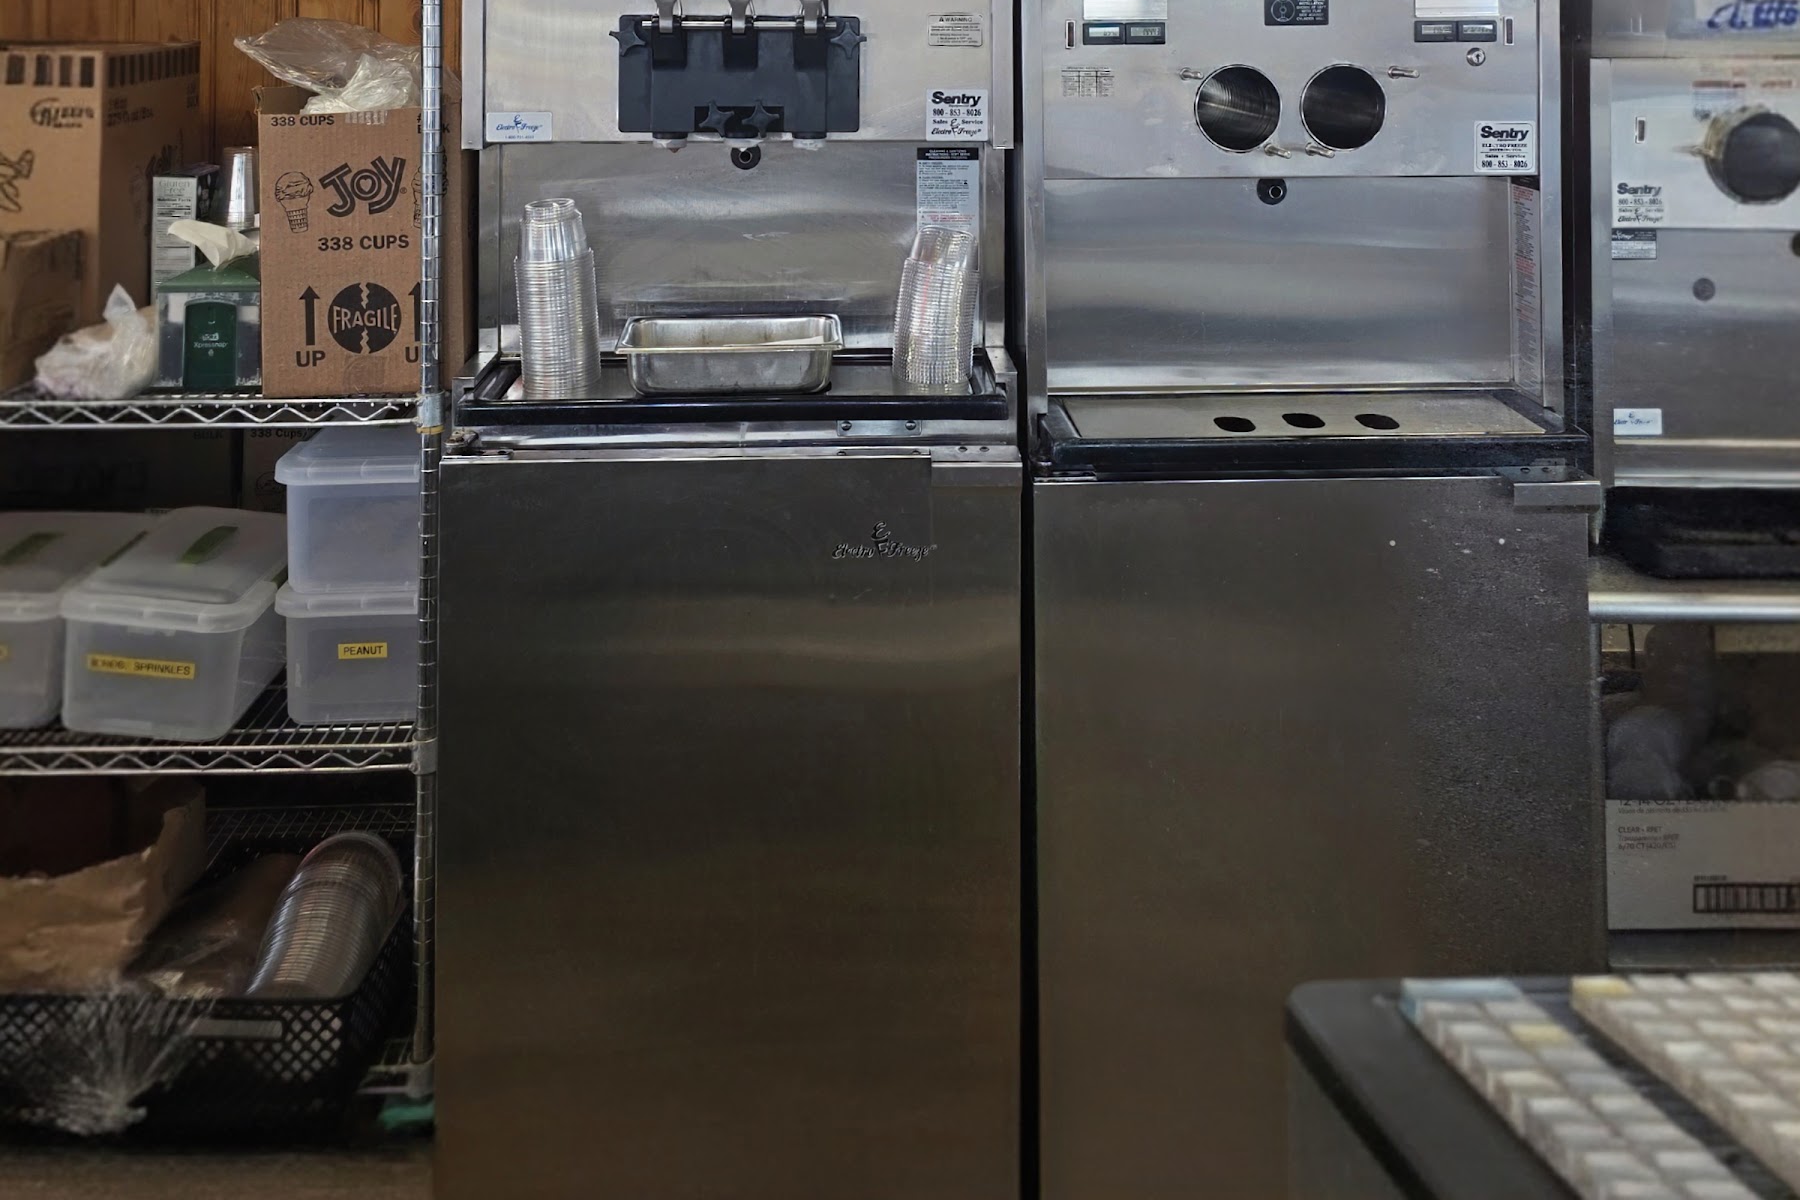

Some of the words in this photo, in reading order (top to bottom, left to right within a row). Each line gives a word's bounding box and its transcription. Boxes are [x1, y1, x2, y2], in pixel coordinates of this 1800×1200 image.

[931, 91, 981, 107] Sentry
[932, 108, 944, 116] 800
[950, 108, 961, 116] 853
[966, 108, 981, 116] 8026
[270, 116, 296, 126] 338
[299, 115, 335, 126] CUPS
[1480, 125, 1529, 141] Sentry
[1481, 160, 1492, 168] 800
[1497, 160, 1508, 168] 853
[1513, 160, 1528, 168] 8026
[159, 180, 190, 188] Gluten
[1617, 182, 1662, 197] Sentry
[318, 237, 353, 251] 338
[359, 234, 410, 250] CUPS
[333, 303, 398, 335] FRAGILE
[296, 350, 326, 367] UP
[405, 346, 419, 363] U
[250, 429, 272, 438] 338
[343, 645, 384, 656] PEANUT
[134, 661, 191, 676] SPRINKLES
